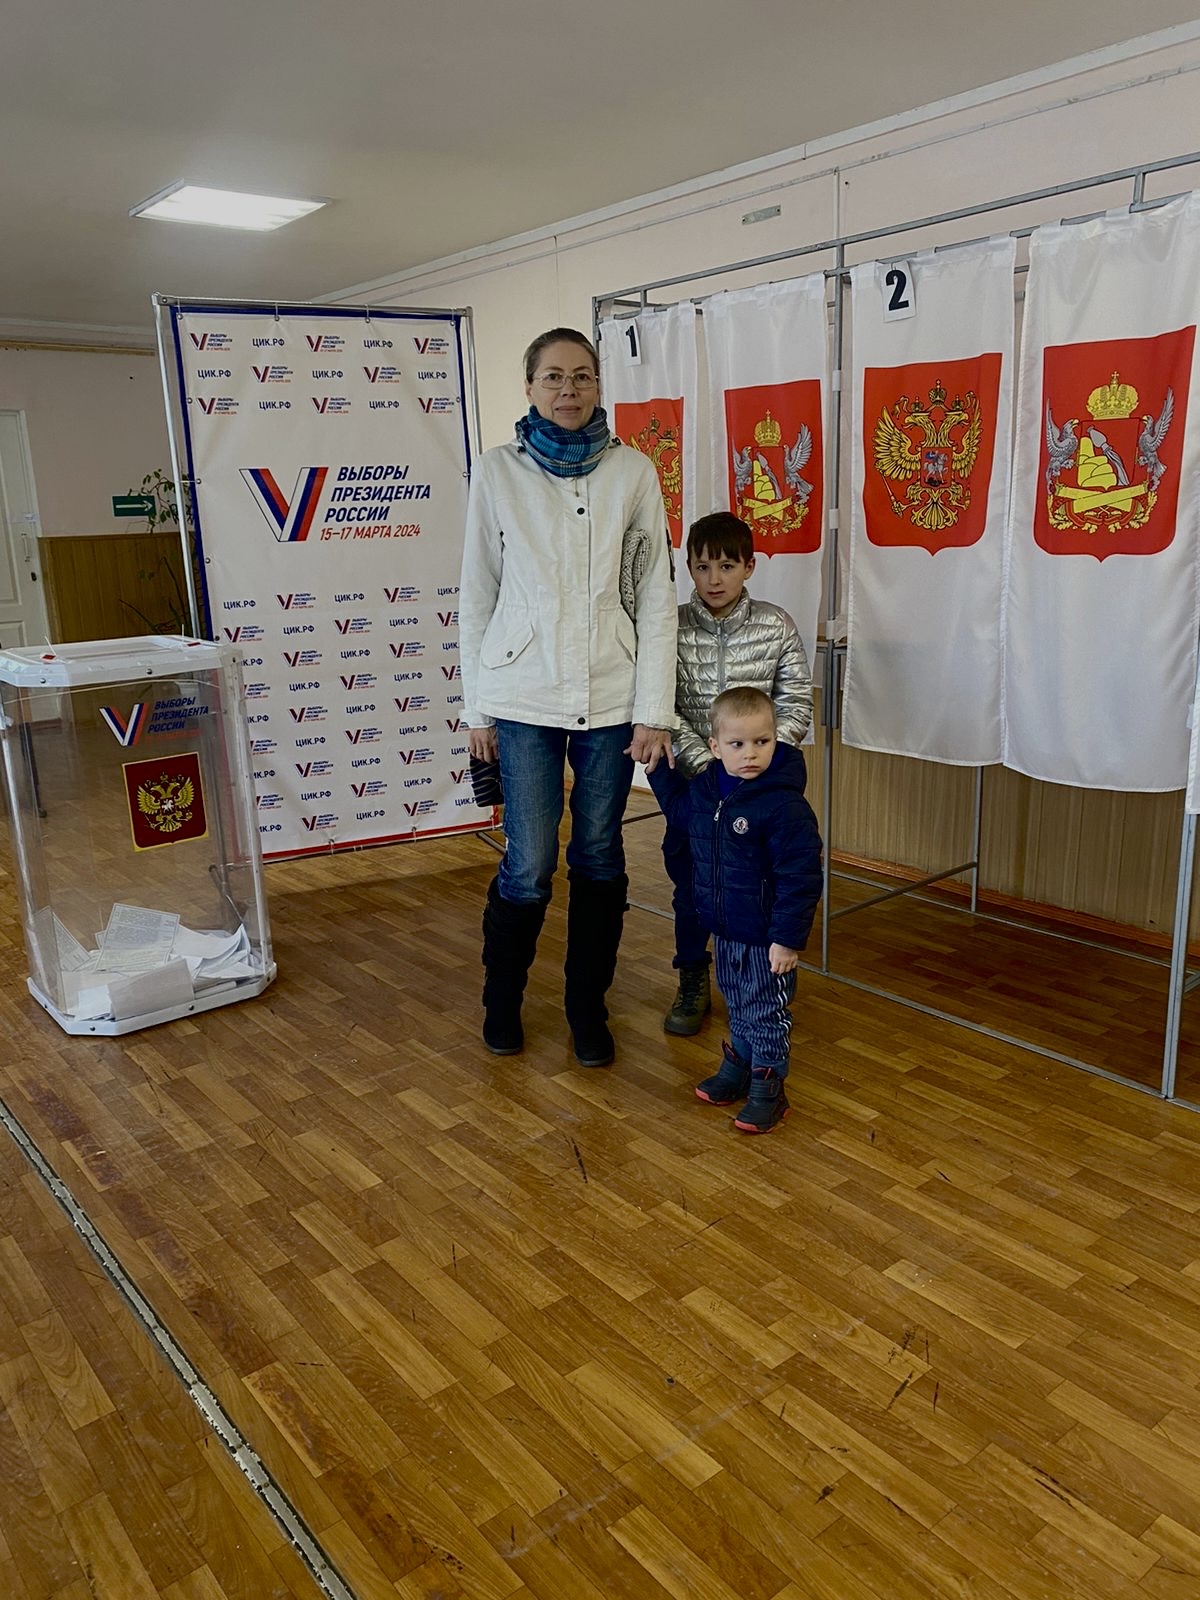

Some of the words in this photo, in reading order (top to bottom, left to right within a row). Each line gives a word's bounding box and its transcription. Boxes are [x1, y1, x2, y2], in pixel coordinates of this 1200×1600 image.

[885, 269, 910, 311] 2
[253, 338, 284, 348] ЦИК.РФ
[364, 340, 393, 349] ЦИК.РФ
[625, 325, 637, 357] 1
[198, 370, 231, 379] ЦИК.РФ
[312, 371, 343, 379] ЦИК.РФ
[418, 372, 447, 380] ЦИК.РФ
[259, 401, 291, 410] ЦИК.РФ
[369, 401, 399, 409] ЦИК.РФ
[337, 465, 409, 481] ВЫБОРЫ
[331, 485, 431, 502] ПРЕЗИДЕНТА
[324, 506, 390, 523] РОССИИ
[353, 525, 392, 539] МАРТА
[393, 524, 421, 538] 2024
[437, 587, 460, 596] ЦИК.Р
[335, 593, 364, 603] ЦИК.РФ
[224, 600, 256, 610] ЦИК.РФ
[390, 618, 418, 627] ЦИК.РФ
[283, 625, 314, 635] ЦИК.РФ
[341, 651, 370, 659] ЦИК.РФ
[394, 672, 422, 682] ЦИК.РФ
[289, 682, 320, 691] ЦИК.РФ
[154, 696, 196, 710] ВЫБОРЫ
[151, 706, 209, 721] ПРЕЗИДЕНТА
[346, 704, 375, 714] ЦИК.РФ
[148, 721, 186, 733] РОССИИ
[399, 725, 427, 735] ЦИК.РФ
[296, 738, 325, 747] ЦИК.РФ
[352, 758, 380, 768] ЦИК.РФ
[404, 778, 432, 787] ЦИК.РФ
[301, 791, 331, 801] ЦИК.РФ
[356, 810, 385, 820] ЦИК.РФ
